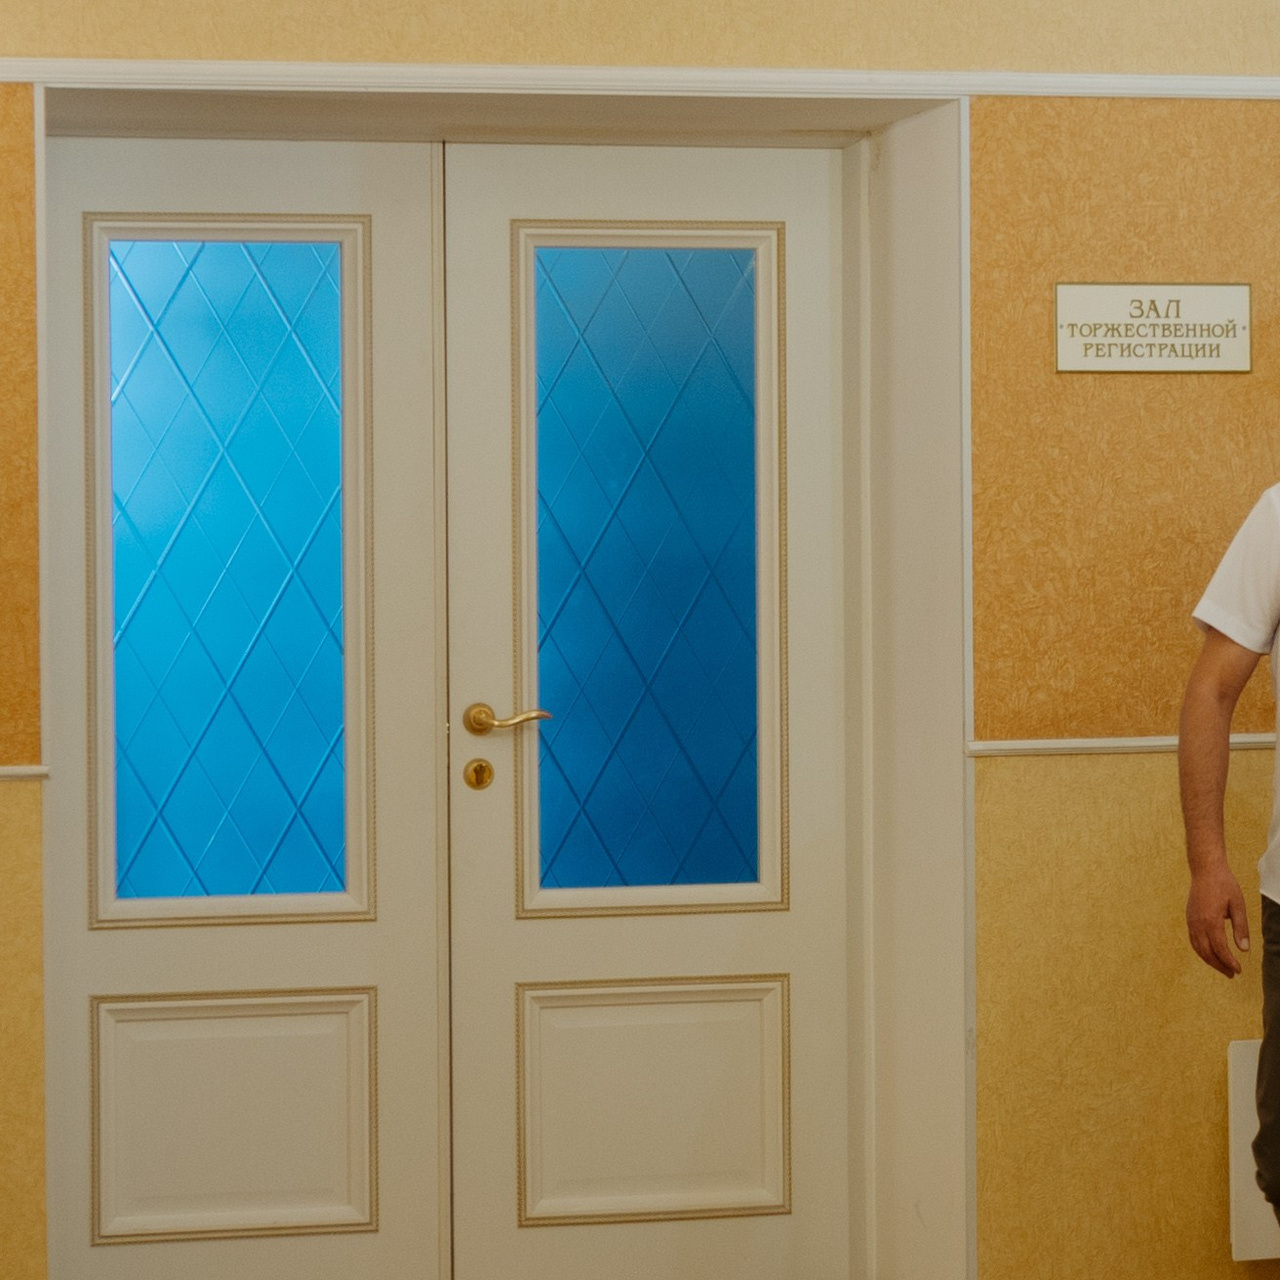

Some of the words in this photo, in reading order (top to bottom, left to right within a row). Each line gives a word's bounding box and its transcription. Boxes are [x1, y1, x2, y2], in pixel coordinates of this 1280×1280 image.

[1129, 299, 1181, 319] ЗАЛ
[1067, 320, 1237, 338] ТОРЖЕСТВЕННОЙ
[1083, 343, 1221, 360] РЕГИСТРАЦИИ
